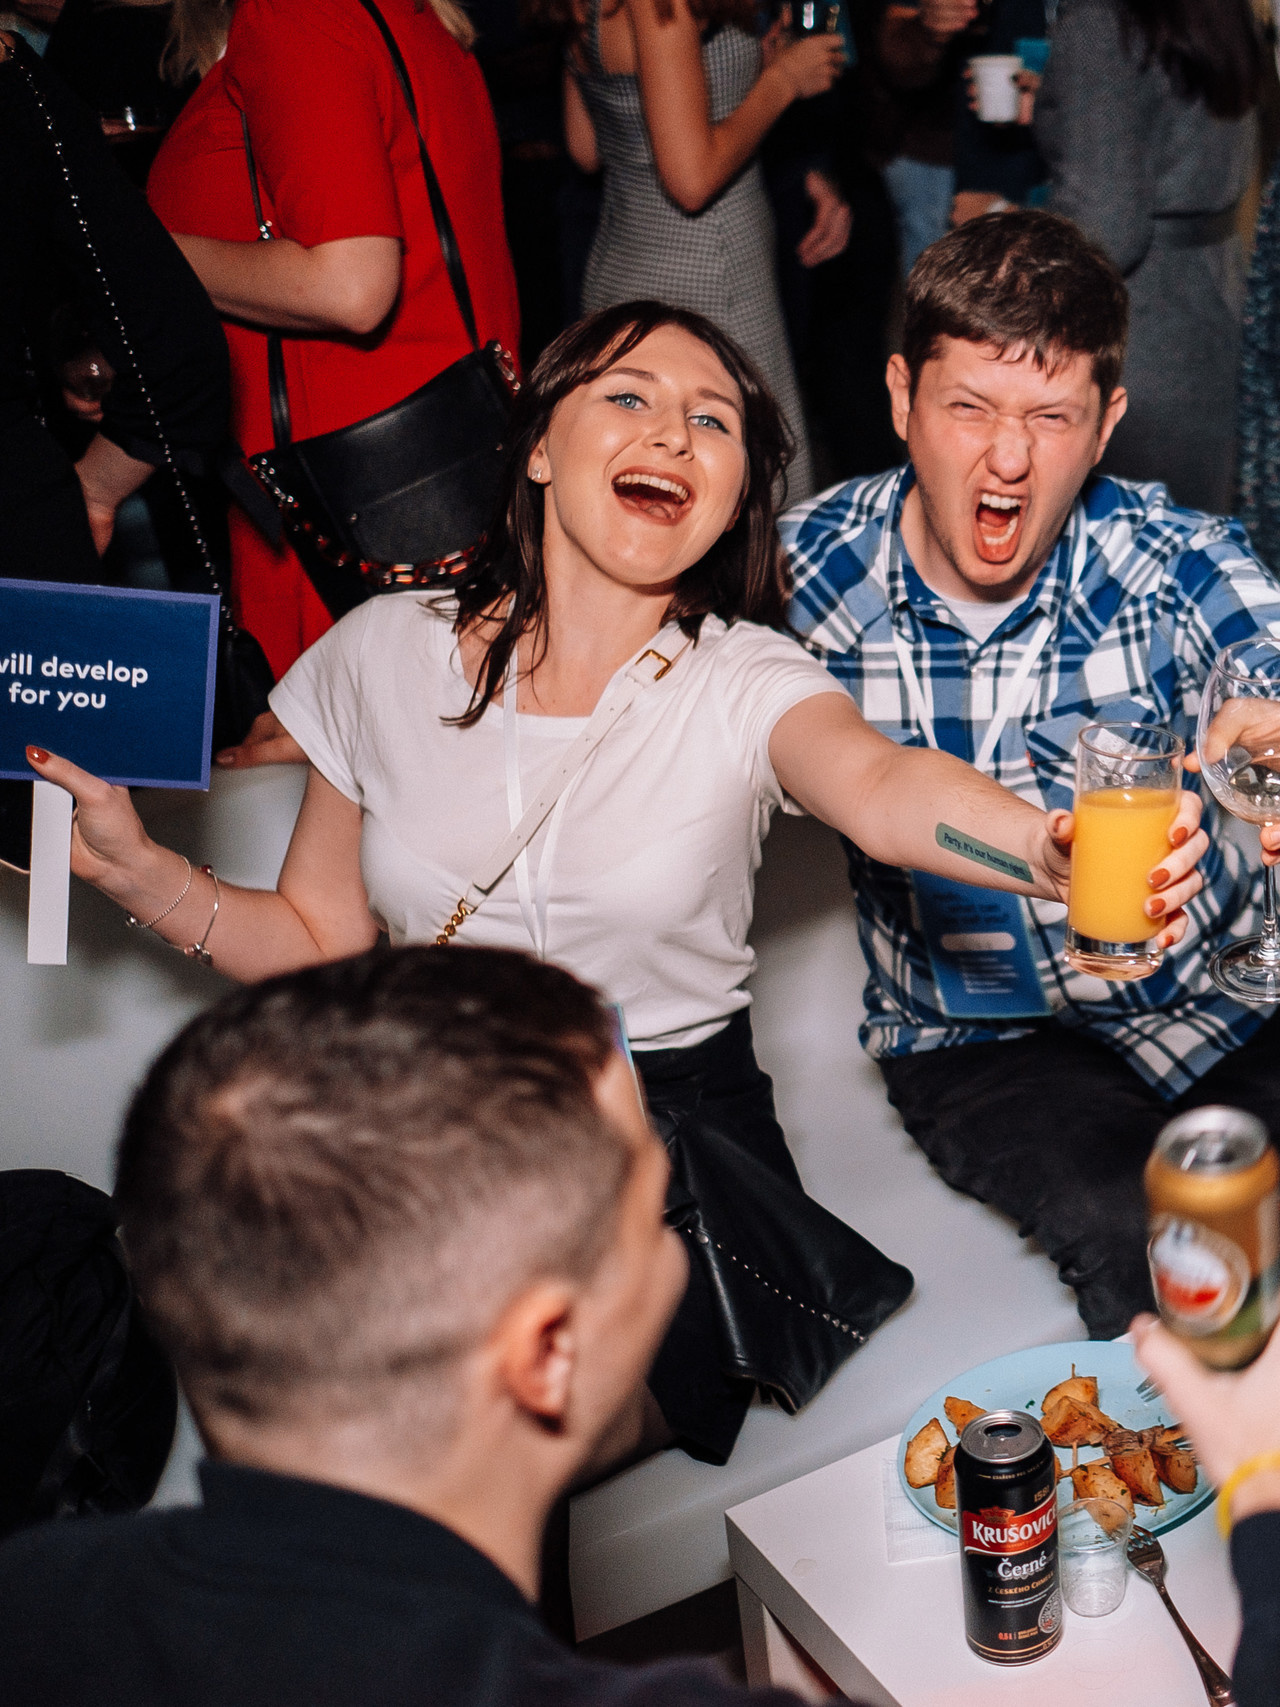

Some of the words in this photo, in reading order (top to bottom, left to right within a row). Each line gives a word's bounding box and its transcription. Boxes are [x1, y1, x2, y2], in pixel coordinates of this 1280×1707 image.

[41, 655, 148, 688] develop
[8, 681, 50, 705] for
[57, 689, 106, 711] you
[975, 848, 986, 859] our
[986, 851, 1009, 868] human
[997, 1550, 1047, 1578] Černé
